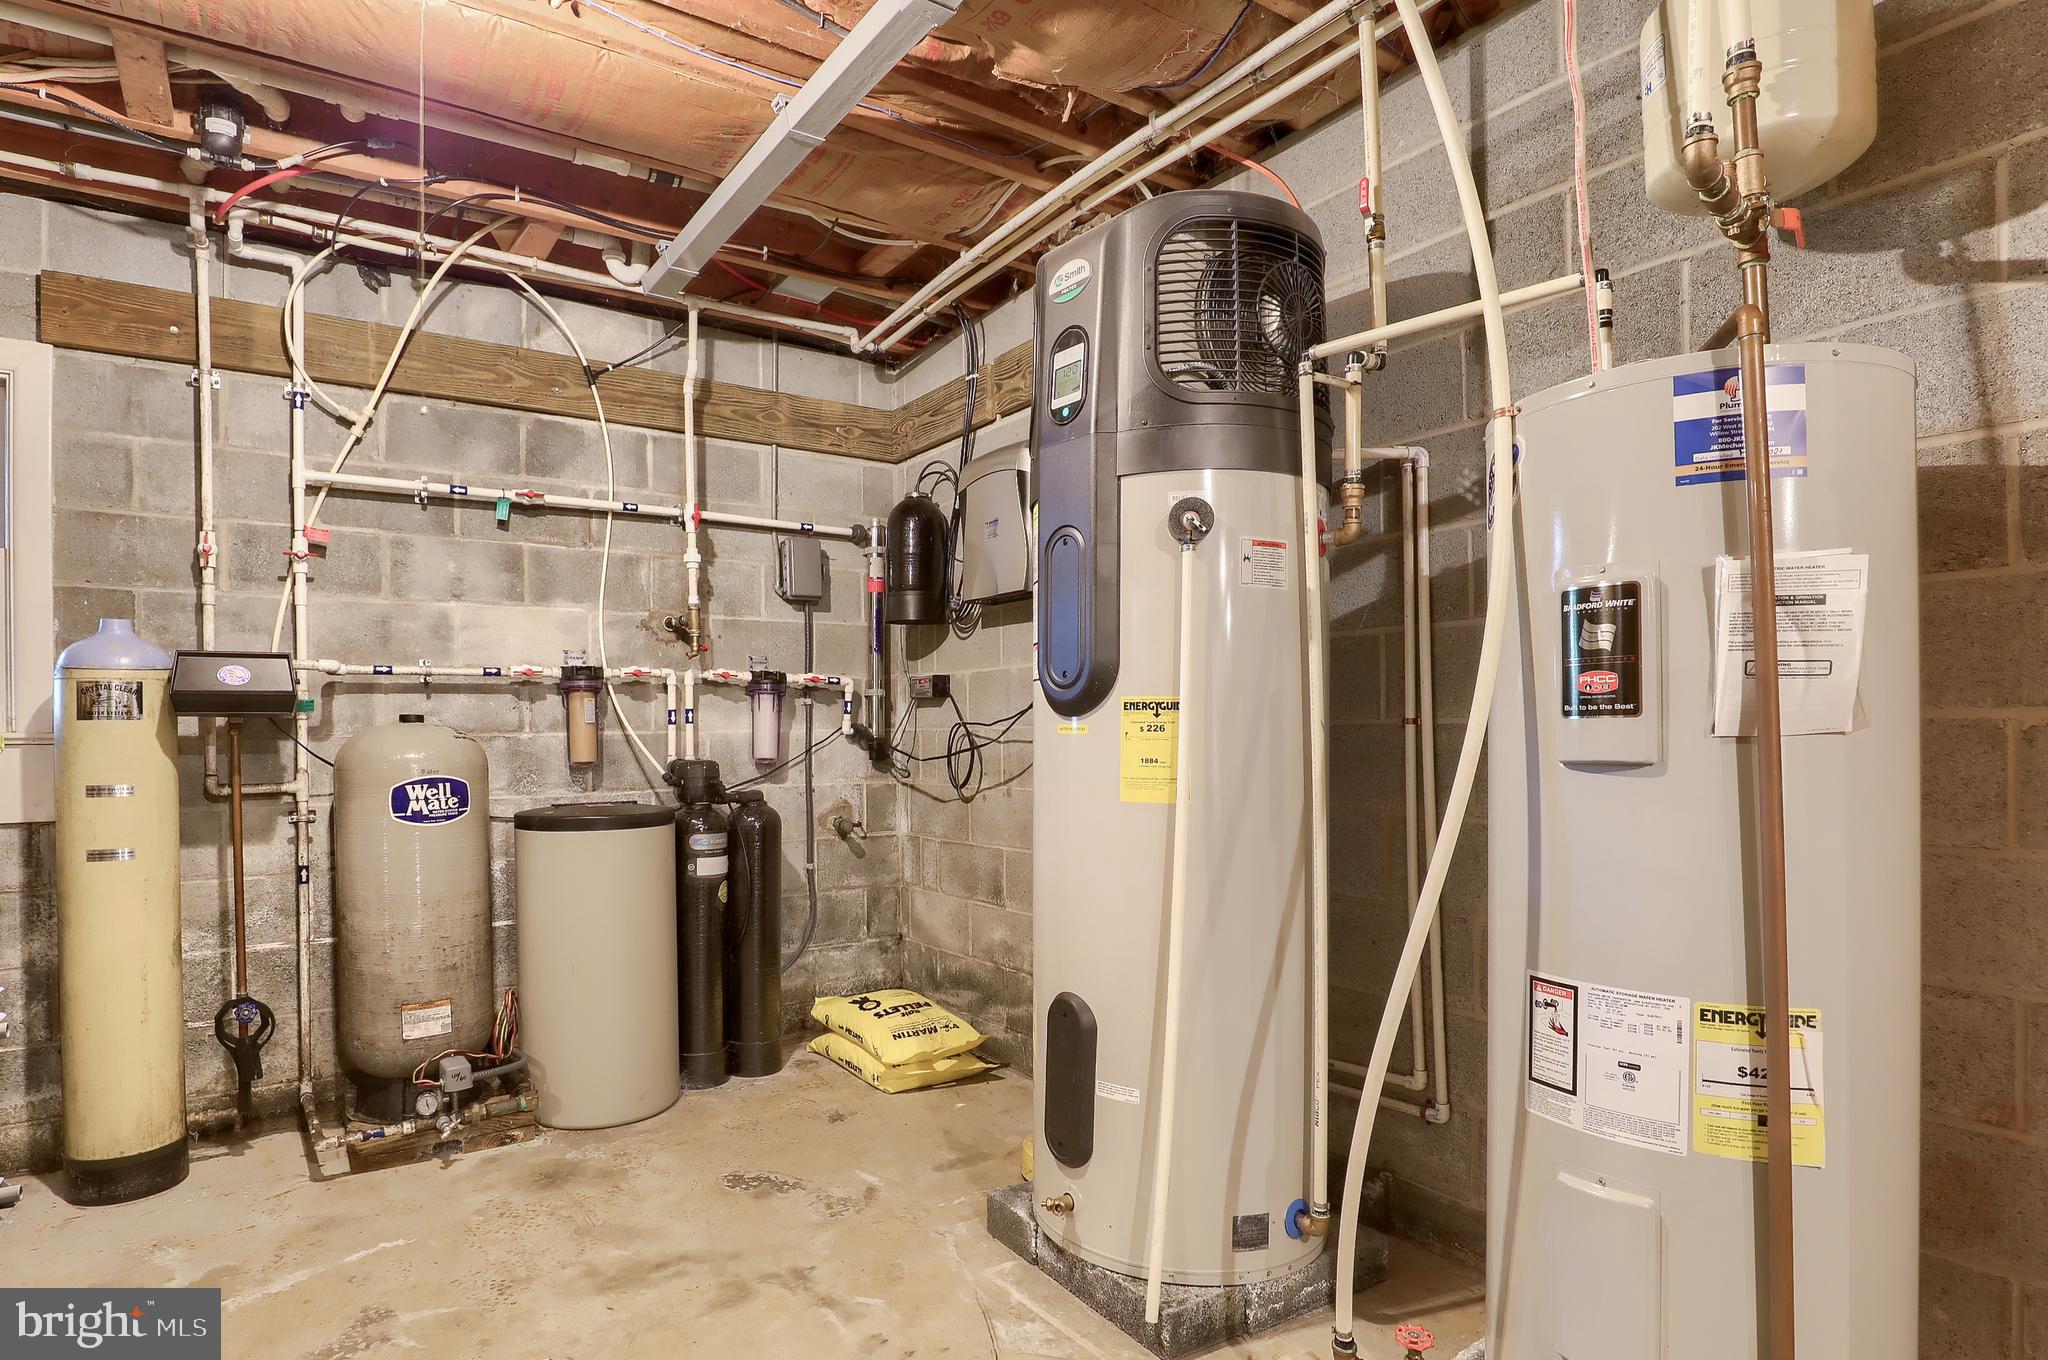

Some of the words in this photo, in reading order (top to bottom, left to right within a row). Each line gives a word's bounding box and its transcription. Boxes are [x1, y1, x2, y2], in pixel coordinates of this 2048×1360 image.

[1064, 264, 1086, 282] Smith
[1062, 364, 1078, 379] 120
[1694, 464, 1723, 472] 24-Hour
[1563, 601, 1603, 613] BRADFORD
[1604, 598, 1636, 608] WHITE
[1579, 674, 1617, 684] PHCC
[80, 683, 112, 695] CRYSTAL
[114, 684, 139, 696] CLEAR
[1588, 703, 1598, 711] be
[1146, 724, 1166, 733] 226
[404, 782, 452, 801] Well
[405, 796, 460, 817] Mate
[1542, 985, 1568, 997] DANGER
[873, 1000, 934, 1020] PELLETS
[892, 1025, 939, 1041] MARTIN
